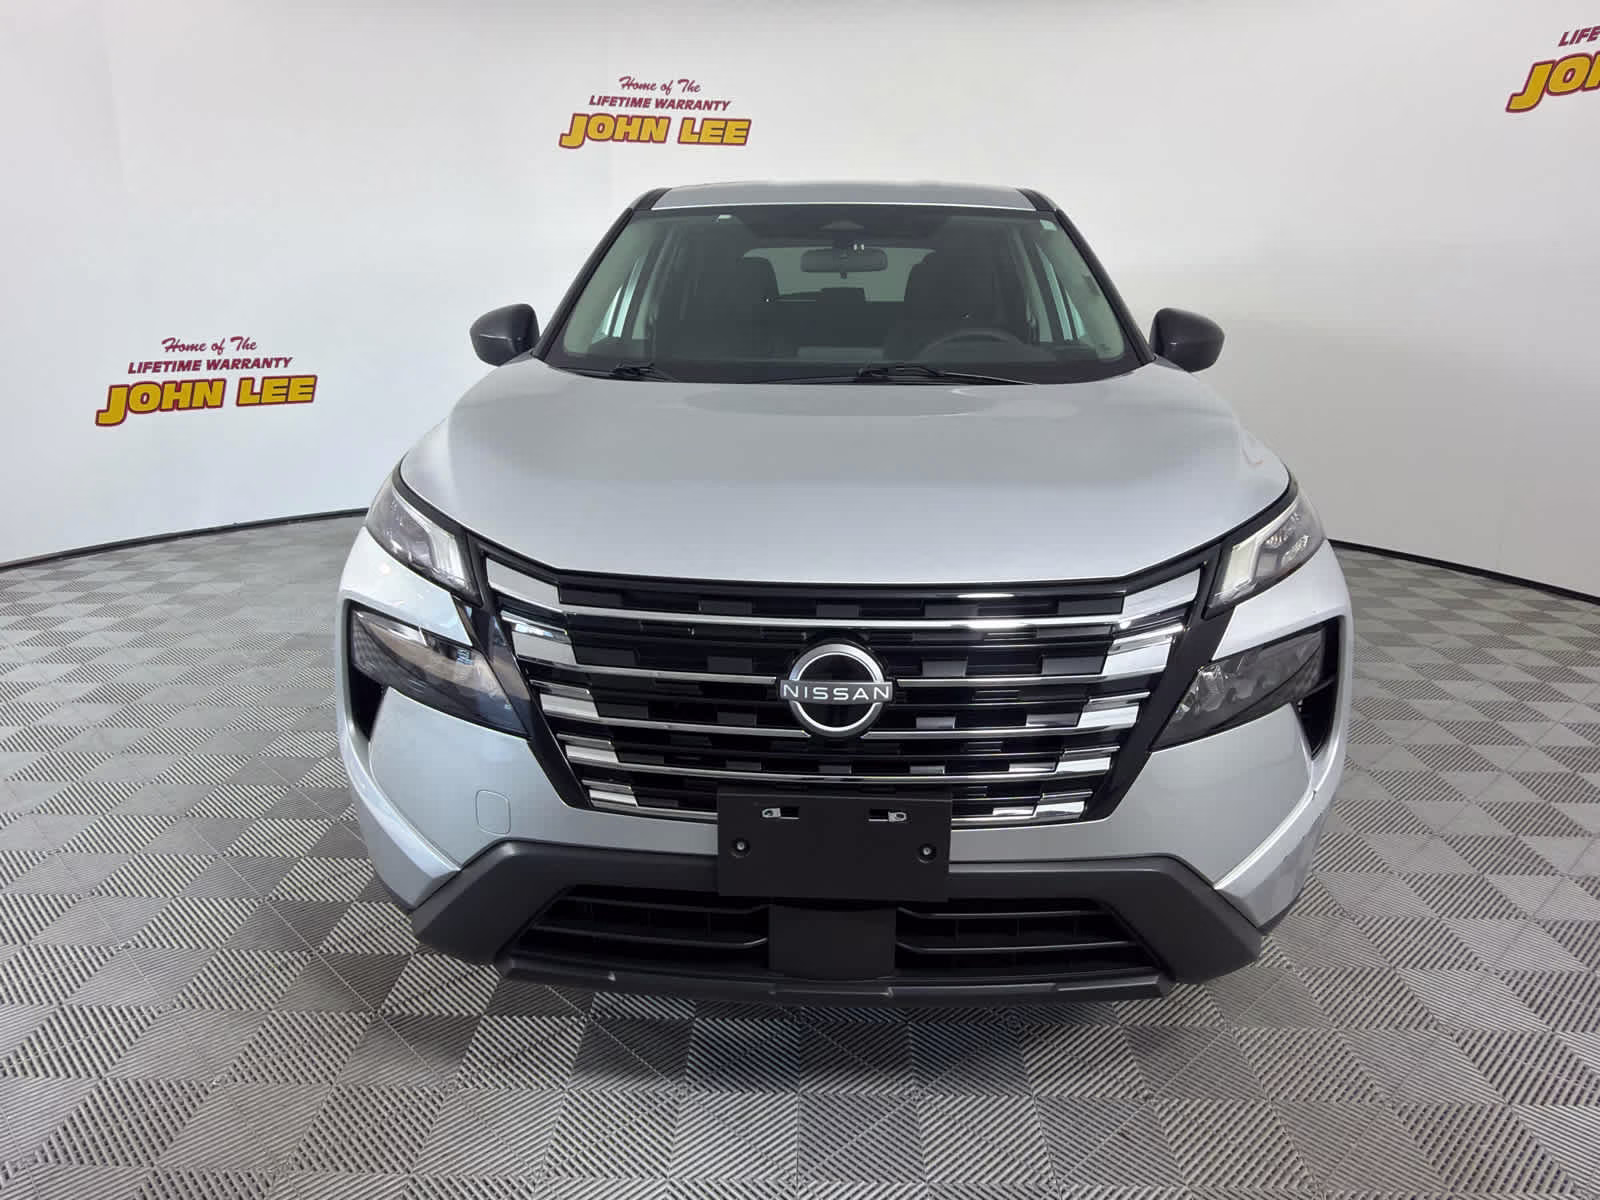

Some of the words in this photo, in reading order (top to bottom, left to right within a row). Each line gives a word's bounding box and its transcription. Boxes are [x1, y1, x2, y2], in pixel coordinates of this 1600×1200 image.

[618, 75, 657, 91] Home
[660, 80, 674, 95] of
[677, 78, 701, 93] The
[589, 95, 651, 108] LIFETIME
[655, 98, 731, 111] WARRANTY
[559, 113, 671, 149] JOHN
[677, 117, 752, 146] LEE
[161, 337, 208, 353] Home
[211, 340, 226, 355] of
[230, 336, 257, 351] The
[128, 359, 202, 374] LIFETIME
[206, 357, 293, 371] WARRANTY
[95, 378, 226, 427] JOHN
[236, 375, 318, 407] LEE
[783, 684, 889, 701] NISSAN
